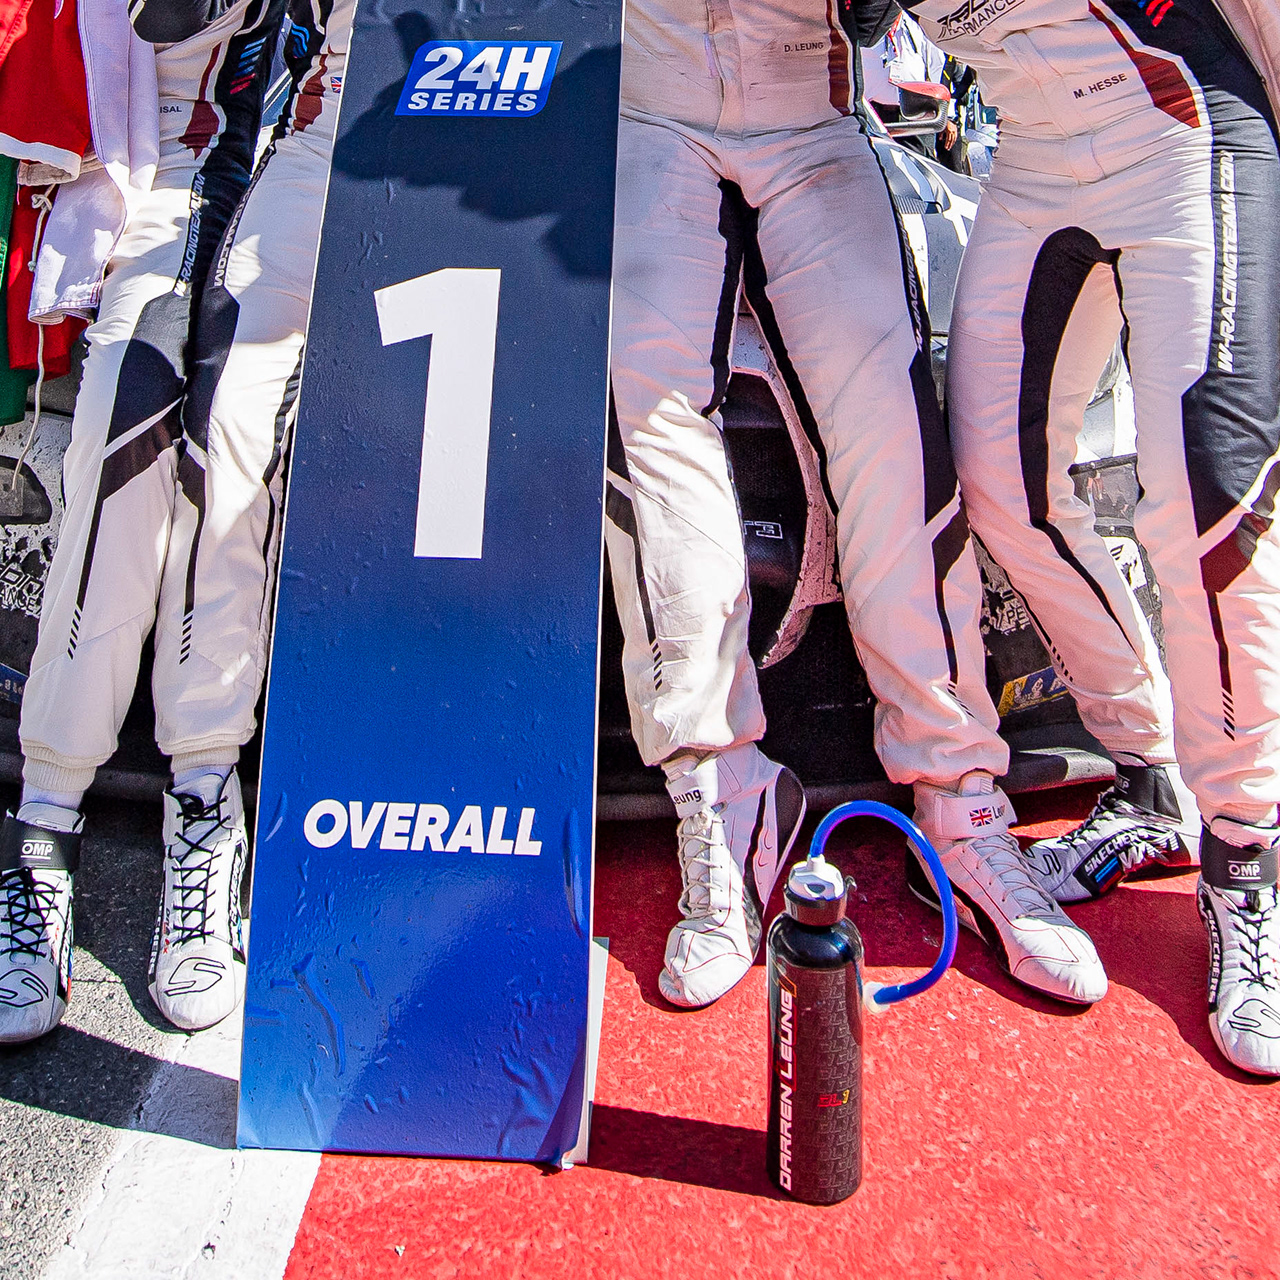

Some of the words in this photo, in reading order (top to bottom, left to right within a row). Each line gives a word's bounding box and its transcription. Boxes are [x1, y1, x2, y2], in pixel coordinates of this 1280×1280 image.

[417, 47, 553, 90] 24H
[784, 44, 793, 52] D.
[795, 42, 824, 52] LEUNG
[407, 92, 539, 111] SERIES
[1073, 88, 1087, 100] M.
[1089, 74, 1127, 93] HESSE
[1217, 151, 1239, 374] W-RACINGTEAM.COM
[374, 268, 501, 559] 1
[303, 800, 543, 856] OVERALL
[21, 844, 53, 856] OMP
[1229, 864, 1260, 876] OMP
[780, 988, 793, 1080] LEUNG
[780, 1083, 792, 1191] DARREN
